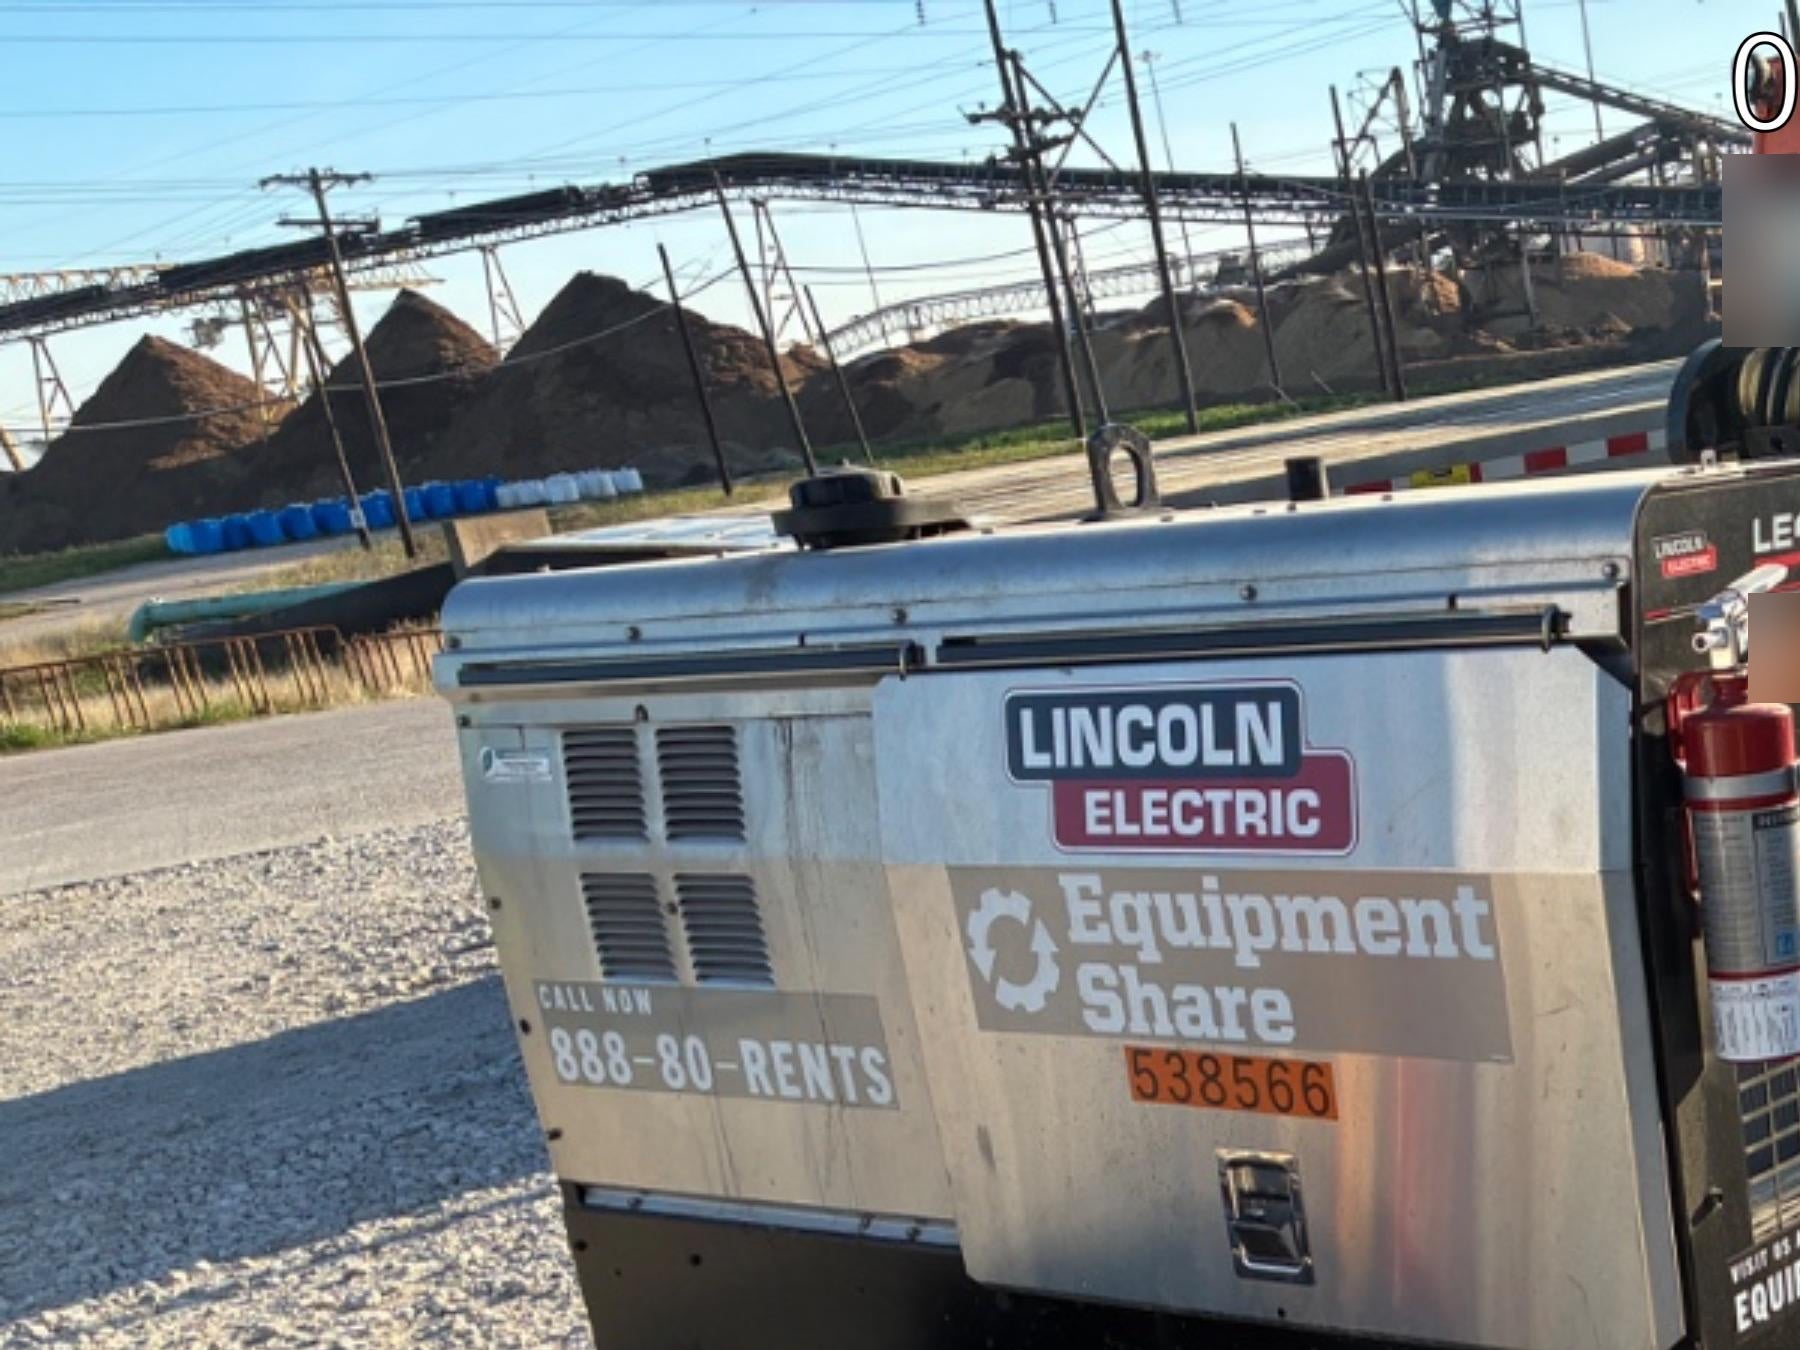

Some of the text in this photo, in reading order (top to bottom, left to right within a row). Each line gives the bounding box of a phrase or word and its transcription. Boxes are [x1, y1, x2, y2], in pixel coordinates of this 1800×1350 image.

[1018, 700, 1285, 769] LINCOLN
[1085, 788, 1321, 837] ELECTRIC
[1057, 873, 1496, 967] Equipment
[538, 984, 653, 1015] CALL NOW
[1076, 961, 1296, 1044] Share
[551, 1027, 893, 1106] 888-80-RENTS
[1132, 1049, 1332, 1117] 538566
[1729, 1248, 1768, 1284] VISIT
[1772, 1236, 1792, 1260] US
